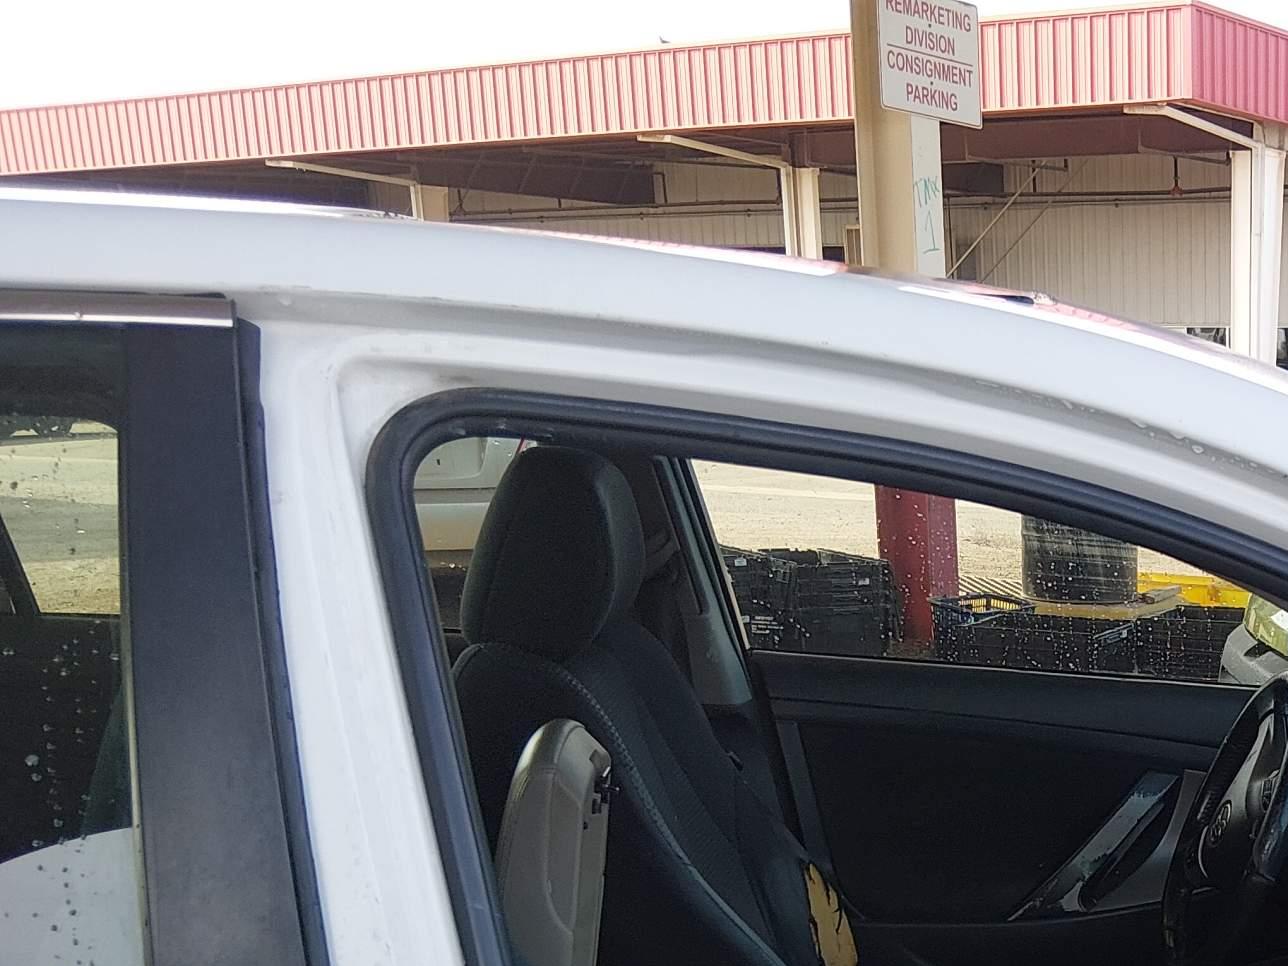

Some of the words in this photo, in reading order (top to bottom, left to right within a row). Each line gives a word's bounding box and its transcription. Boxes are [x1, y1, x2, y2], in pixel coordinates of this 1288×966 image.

[886, 0, 971, 32] REMARKETING
[905, 25, 955, 56] DIVISION
[887, 50, 973, 88] CONSIGNMENT
[906, 83, 958, 111] PARKING
